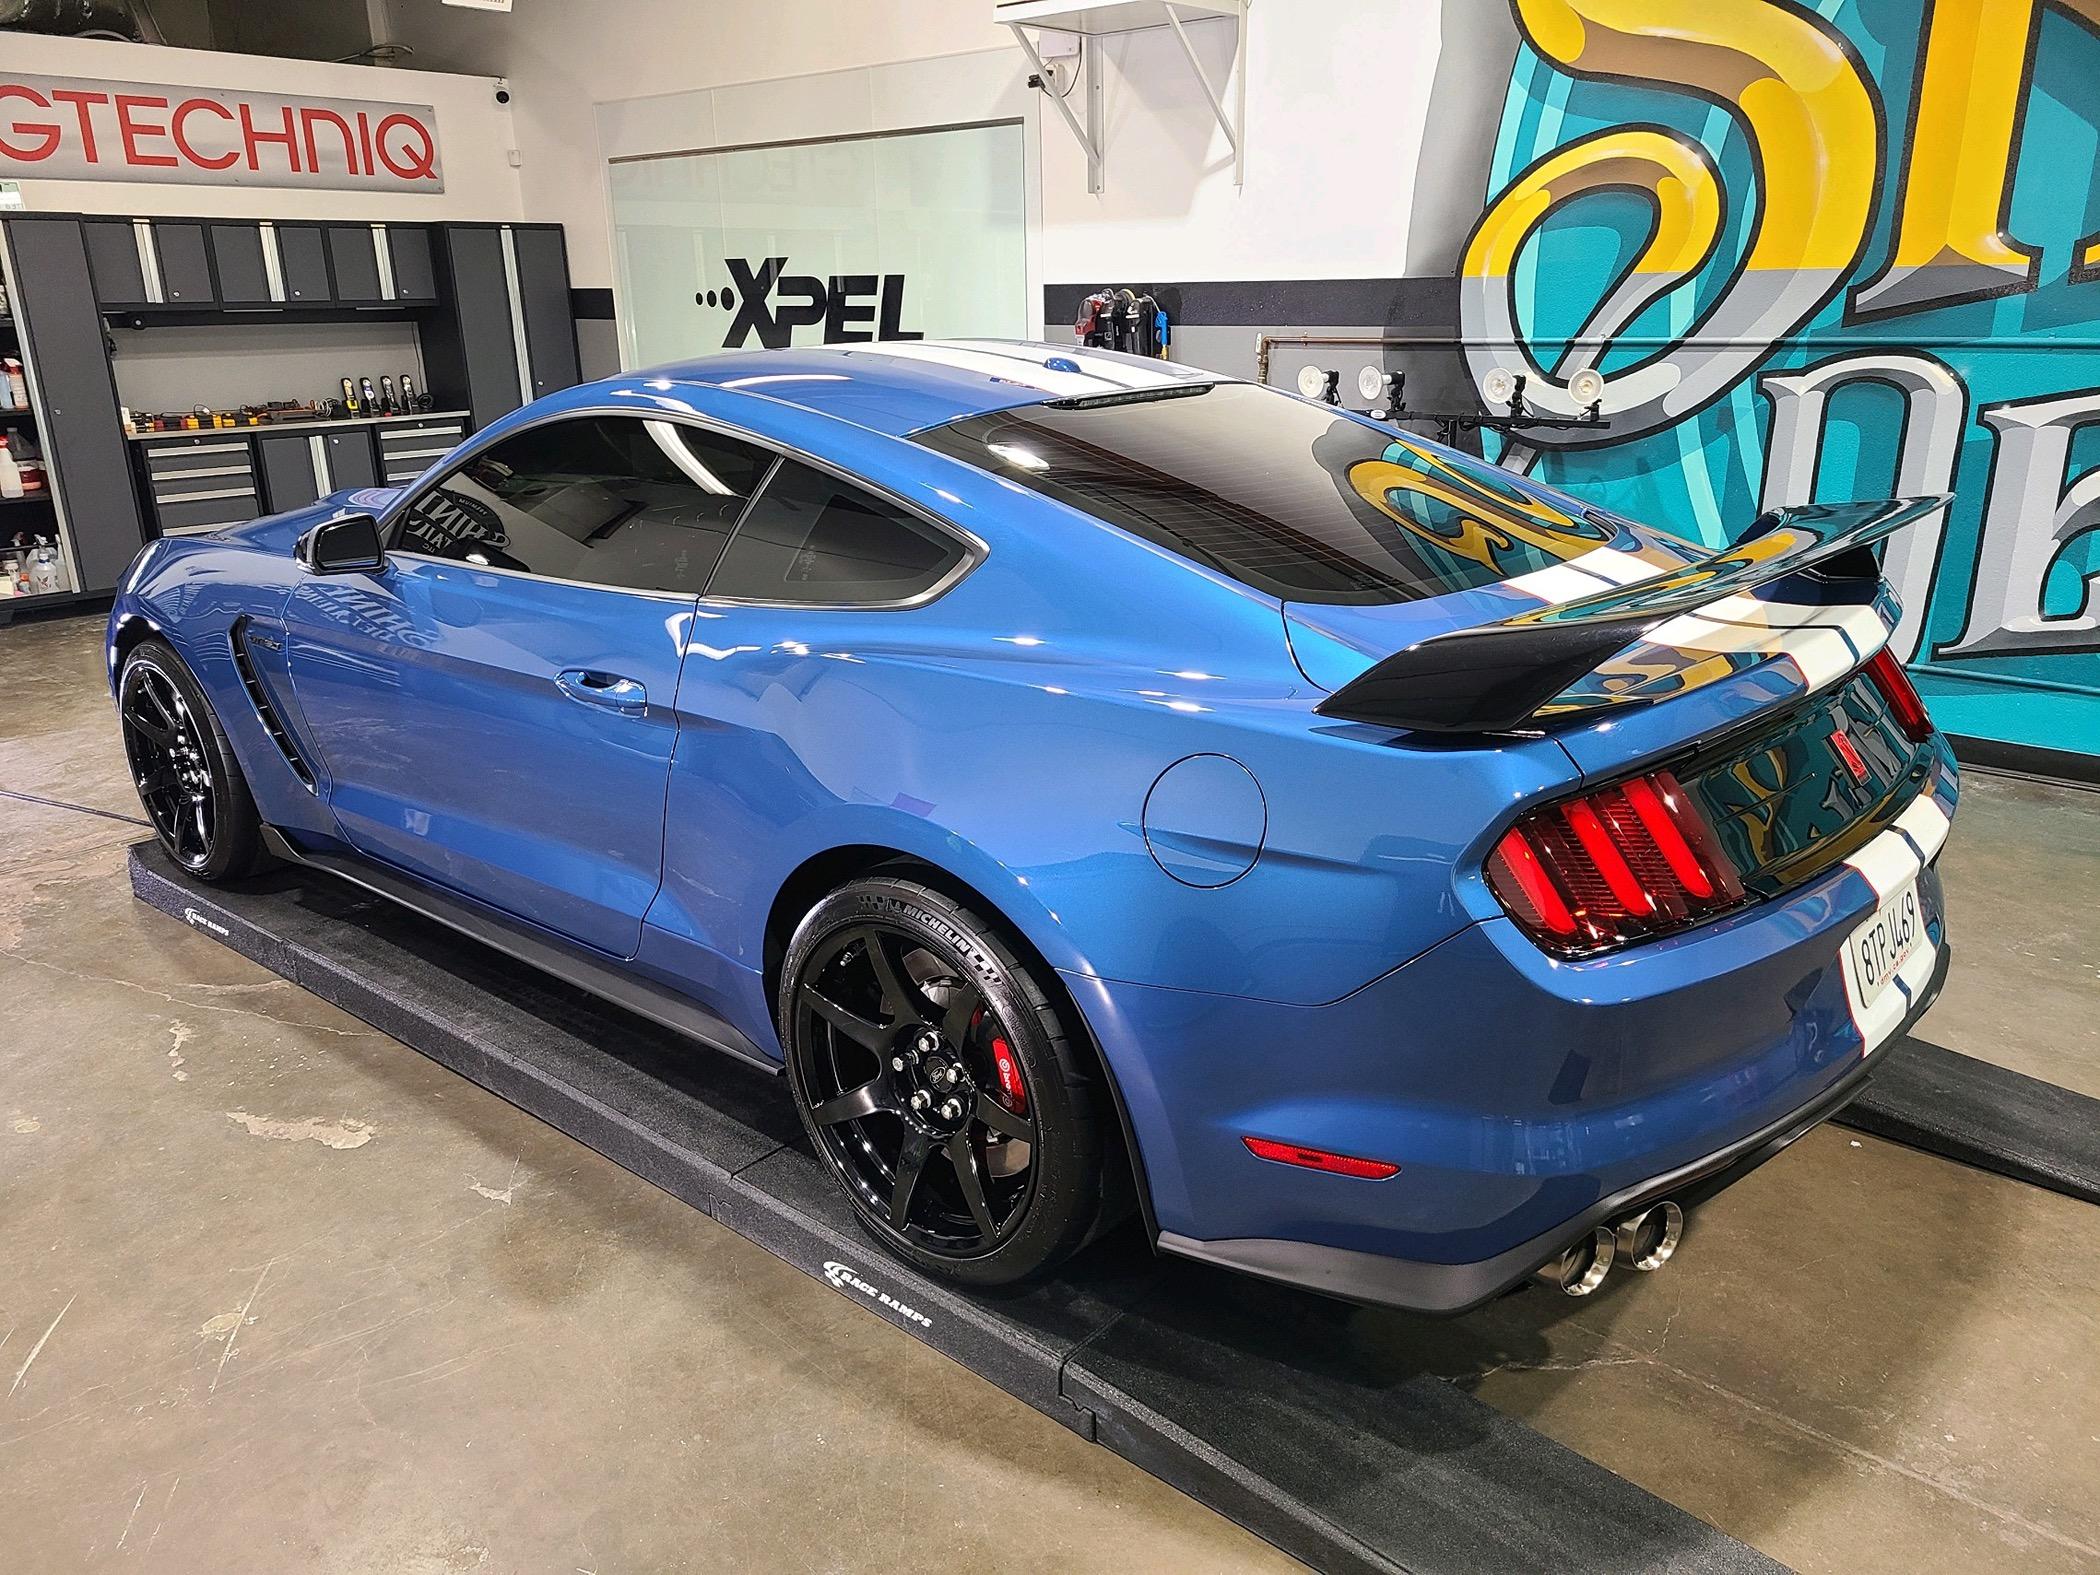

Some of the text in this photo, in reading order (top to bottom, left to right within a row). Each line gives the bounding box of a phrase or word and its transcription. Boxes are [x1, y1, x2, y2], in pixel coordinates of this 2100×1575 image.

[0, 84, 438, 180] GTECHNIQ
[721, 257, 925, 349] XPEL
[903, 904, 973, 958] MICHELIN
[839, 1271, 933, 1328] RACE RAMPS
